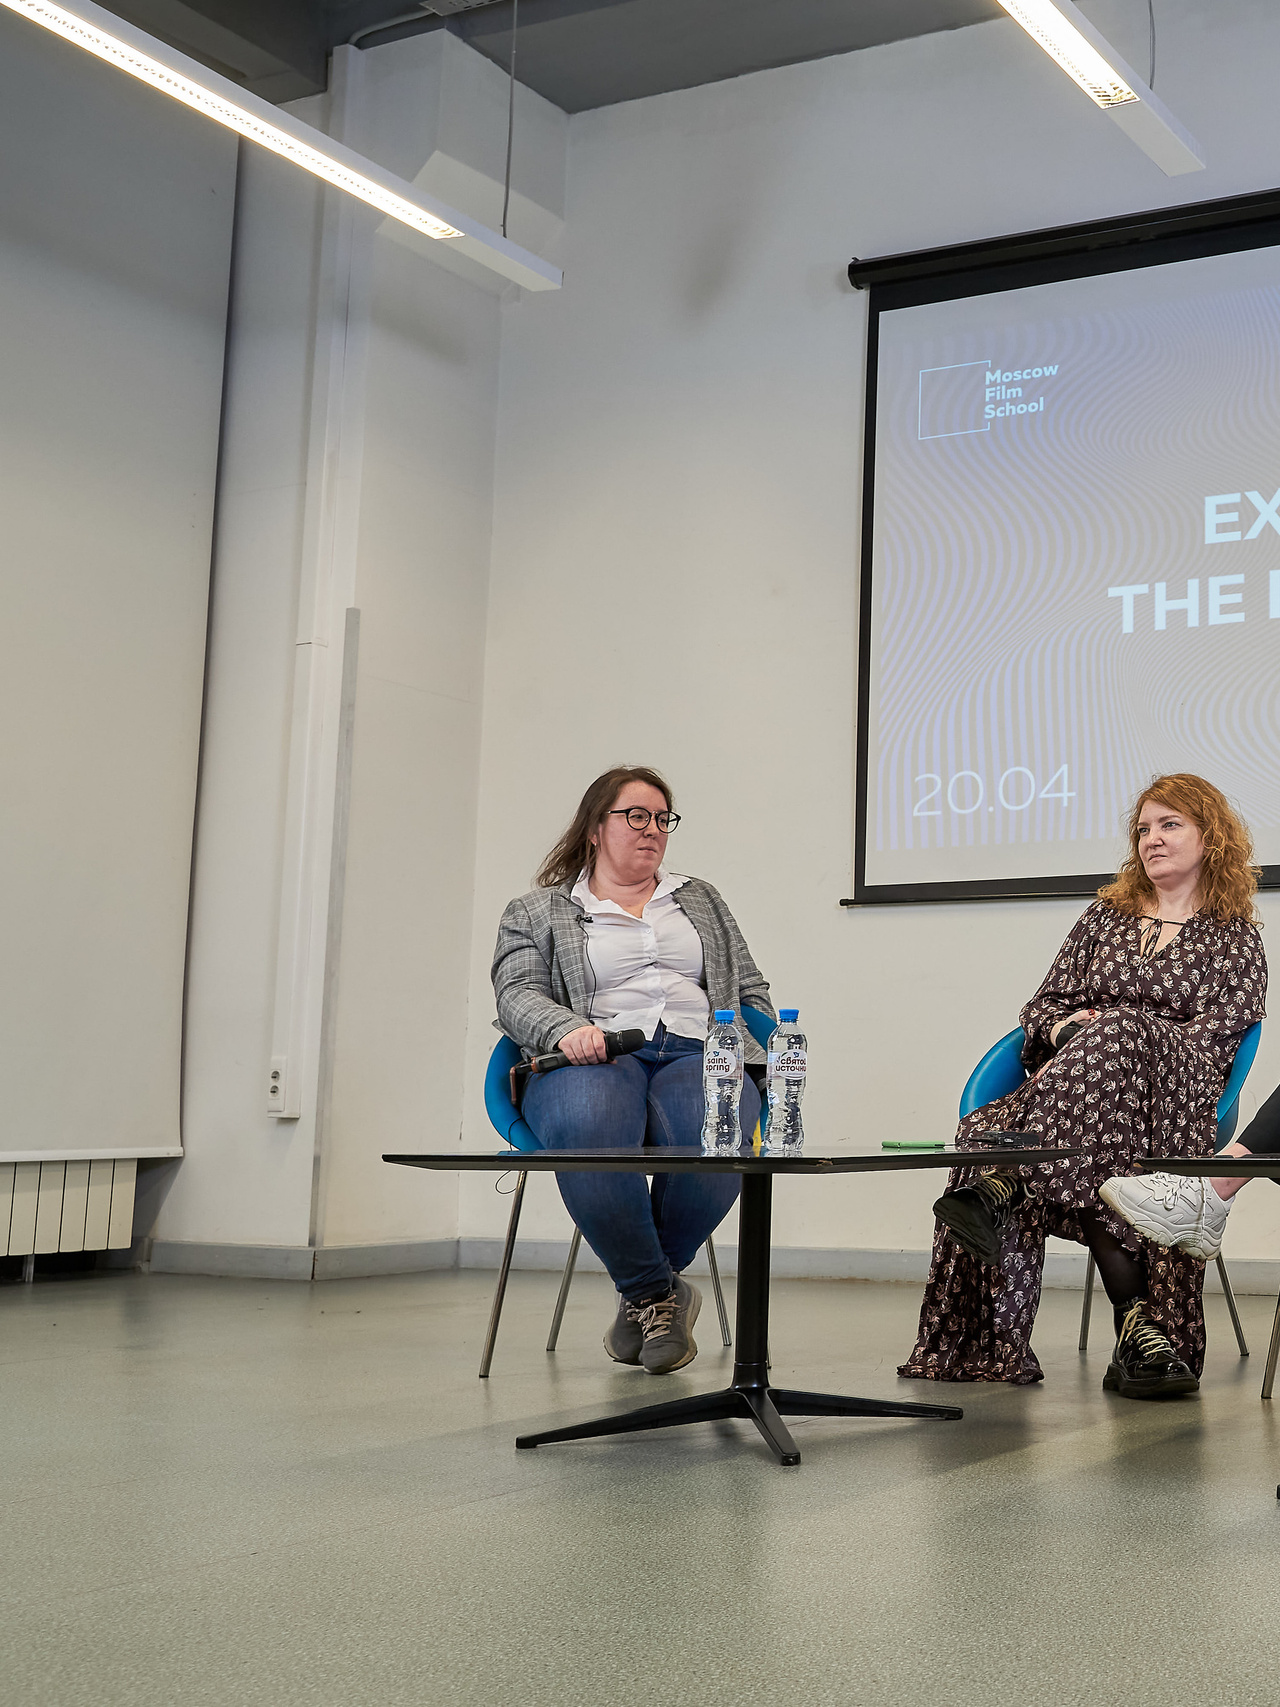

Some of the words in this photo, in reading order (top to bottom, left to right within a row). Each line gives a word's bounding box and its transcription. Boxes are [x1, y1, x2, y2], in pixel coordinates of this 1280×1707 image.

[985, 365, 1059, 385] Moscow
[985, 386, 1022, 402] Film
[983, 396, 1045, 419] School
[1107, 573, 1246, 634] THE
[912, 763, 1077, 817] 20.04
[706, 1064, 730, 1072] spring
